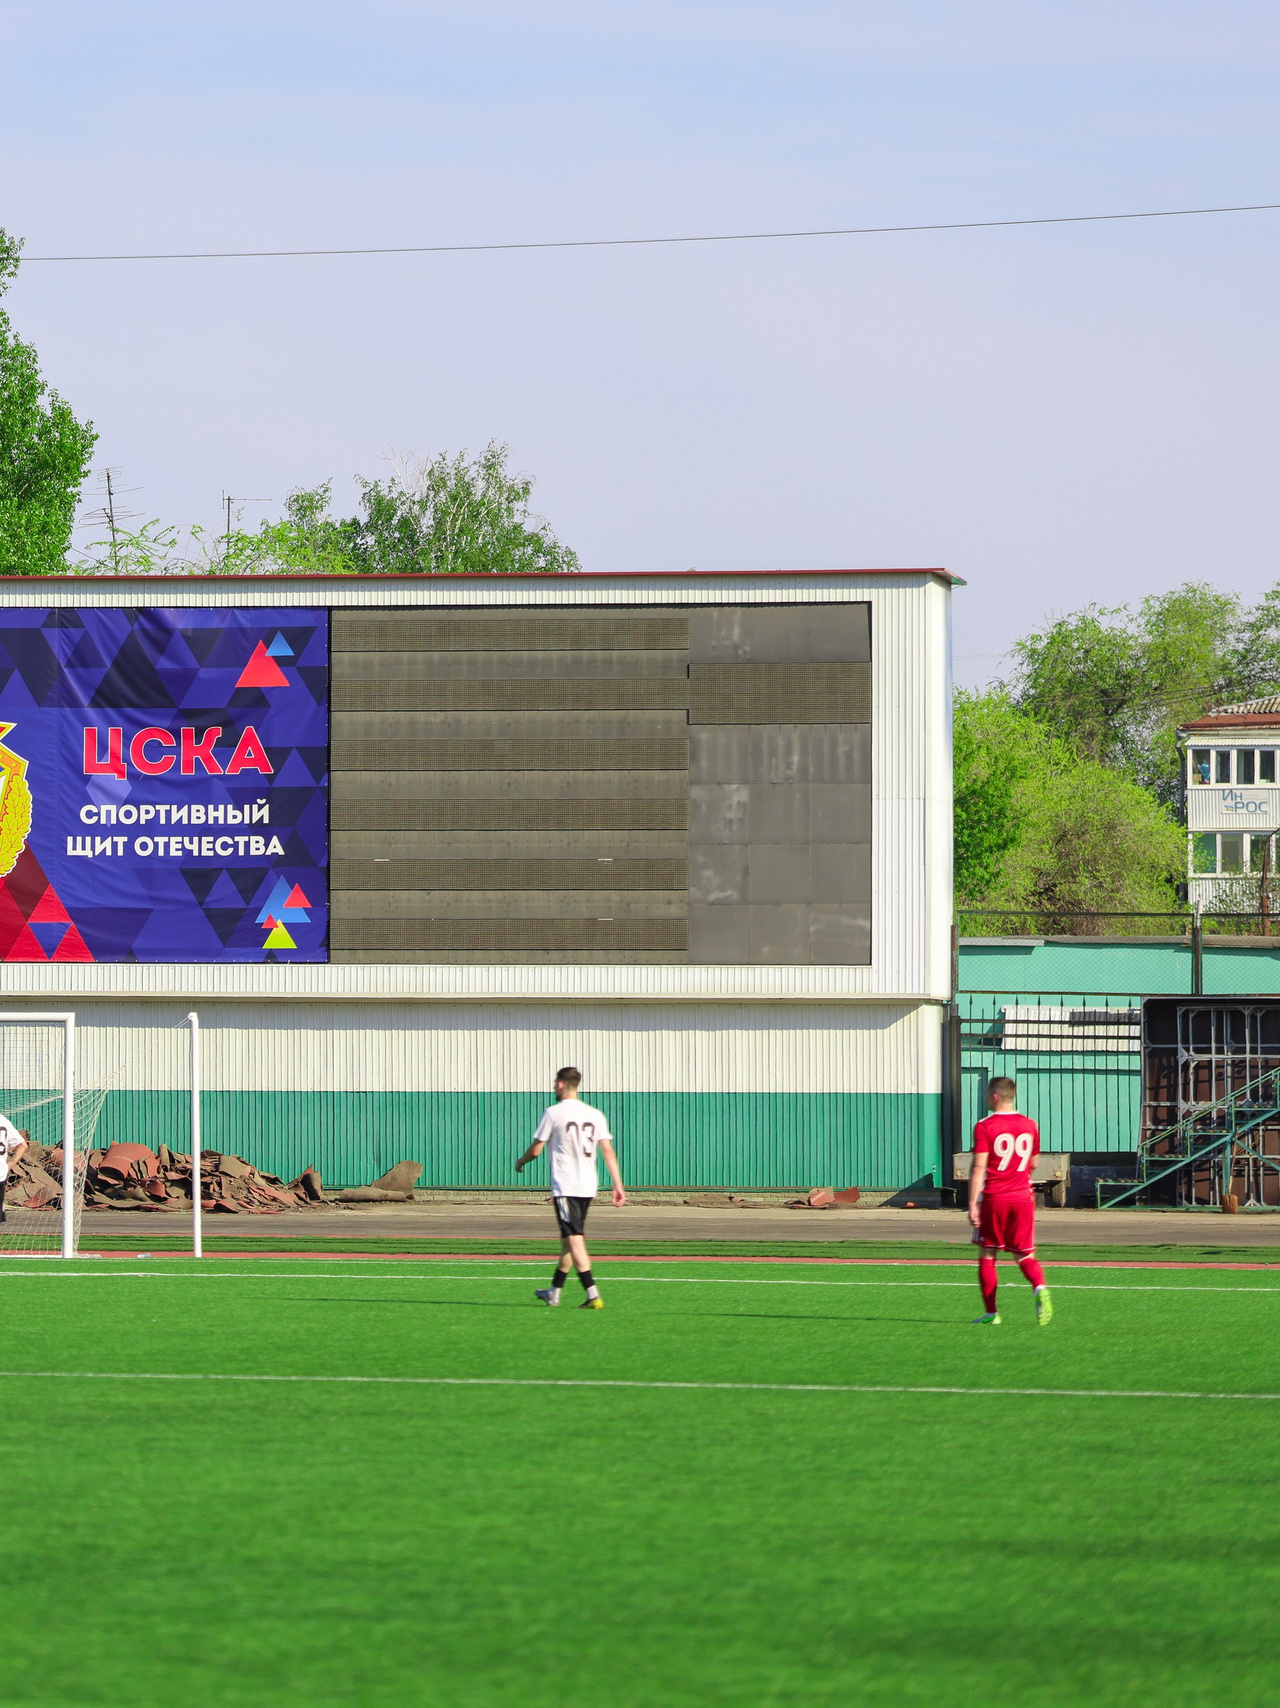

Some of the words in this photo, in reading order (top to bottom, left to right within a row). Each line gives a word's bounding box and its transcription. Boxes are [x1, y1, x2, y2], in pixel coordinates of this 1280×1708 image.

[83, 726, 274, 780] ЦСКА
[79, 798, 270, 825] СПОРТИВНЫЙ
[1234, 801, 1268, 813] РОС
[66, 835, 128, 858] ЩИТ
[133, 835, 285, 857] ОТЕЧЕСТВА
[993, 1132, 1034, 1172] 99
